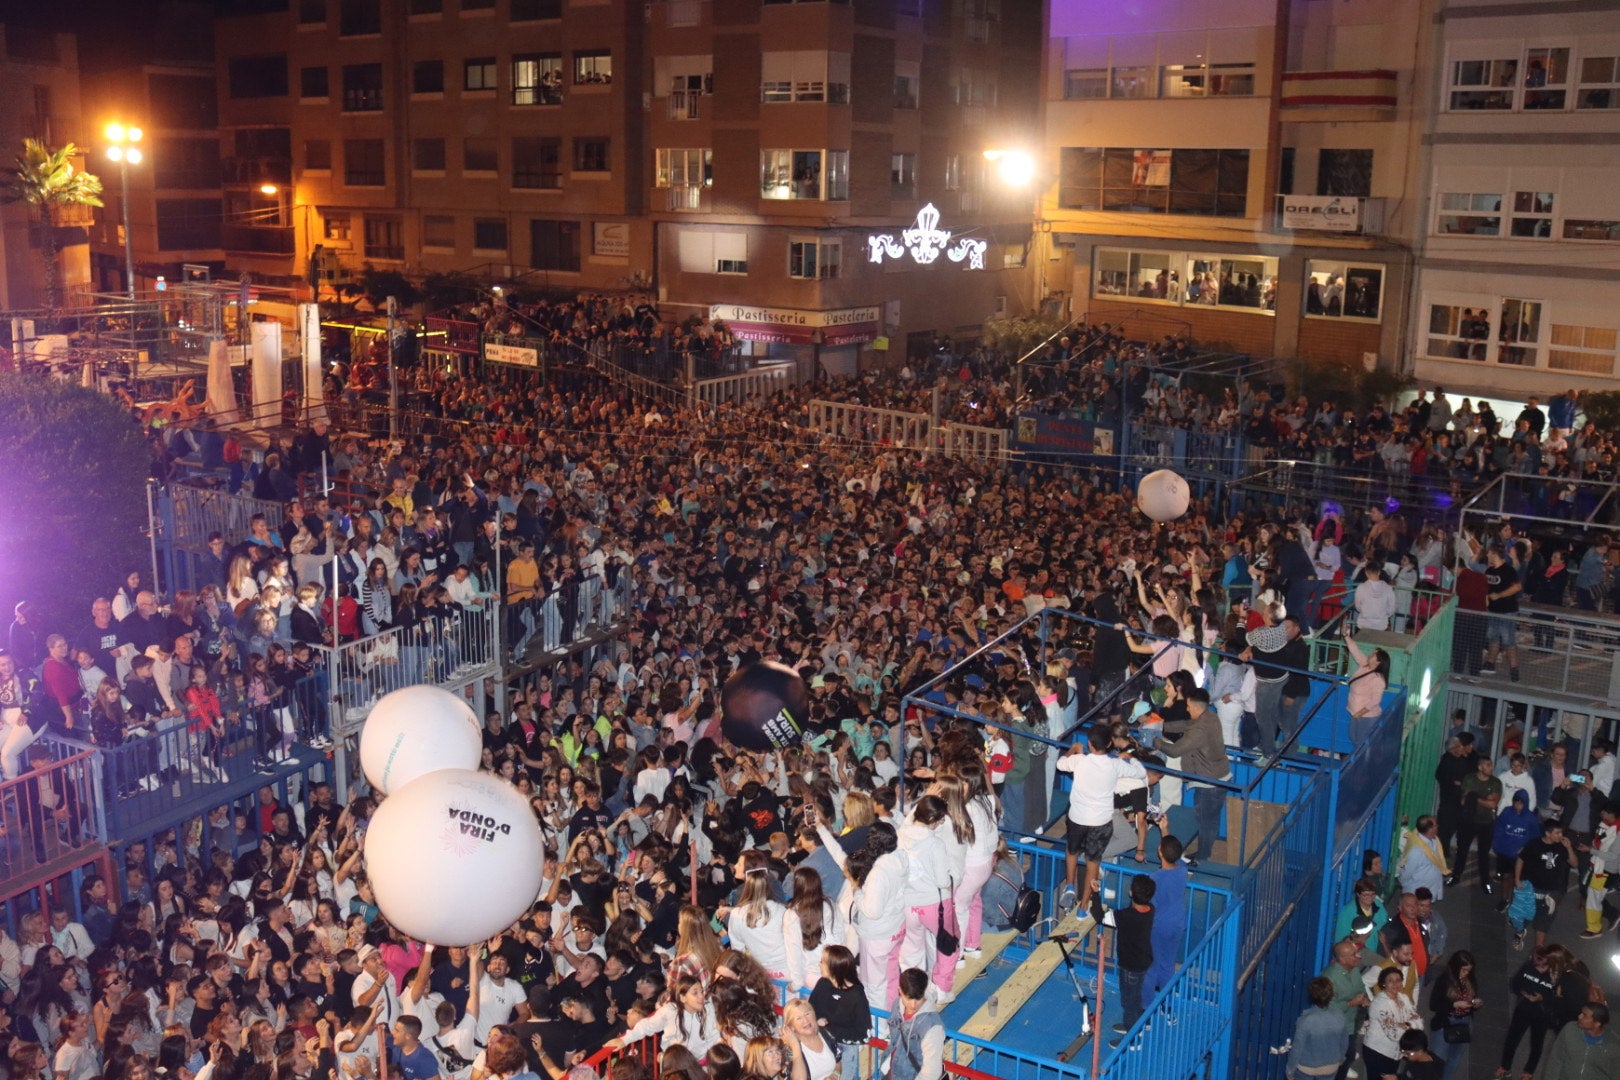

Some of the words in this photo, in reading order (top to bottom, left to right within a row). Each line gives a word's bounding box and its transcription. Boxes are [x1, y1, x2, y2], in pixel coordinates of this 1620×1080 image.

[732, 307, 806, 325] Pastisseria
[823, 309, 875, 325] Pasteleria
[736, 331, 791, 344] Pastisseria
[767, 719, 783, 737] AMB
[449, 807, 511, 835] D'ONDA
[460, 823, 496, 843] FIRA
